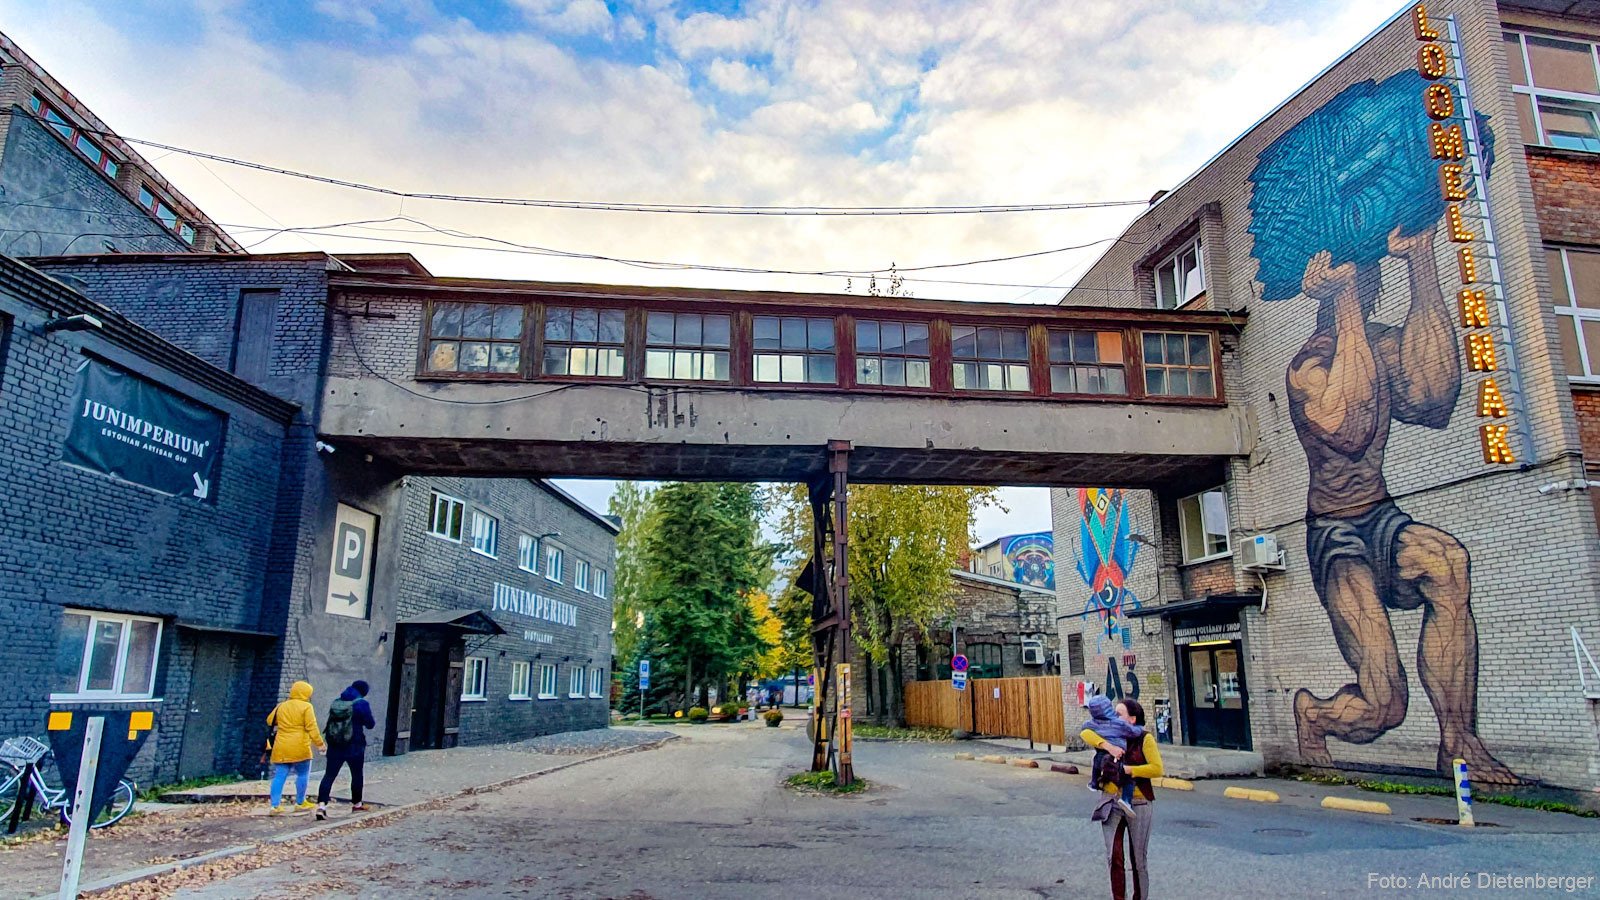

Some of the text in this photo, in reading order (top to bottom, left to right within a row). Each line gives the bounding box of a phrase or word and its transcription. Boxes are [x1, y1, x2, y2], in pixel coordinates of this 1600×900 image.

[1411, 4, 1516, 464] LOOMELINNAK
[82, 399, 206, 458] JUNIMPERIUM
[101, 428, 188, 464] ESTONIAN ARTISAN GIN
[342, 530, 361, 570] P
[492, 581, 578, 627] JUNIMPERIUM
